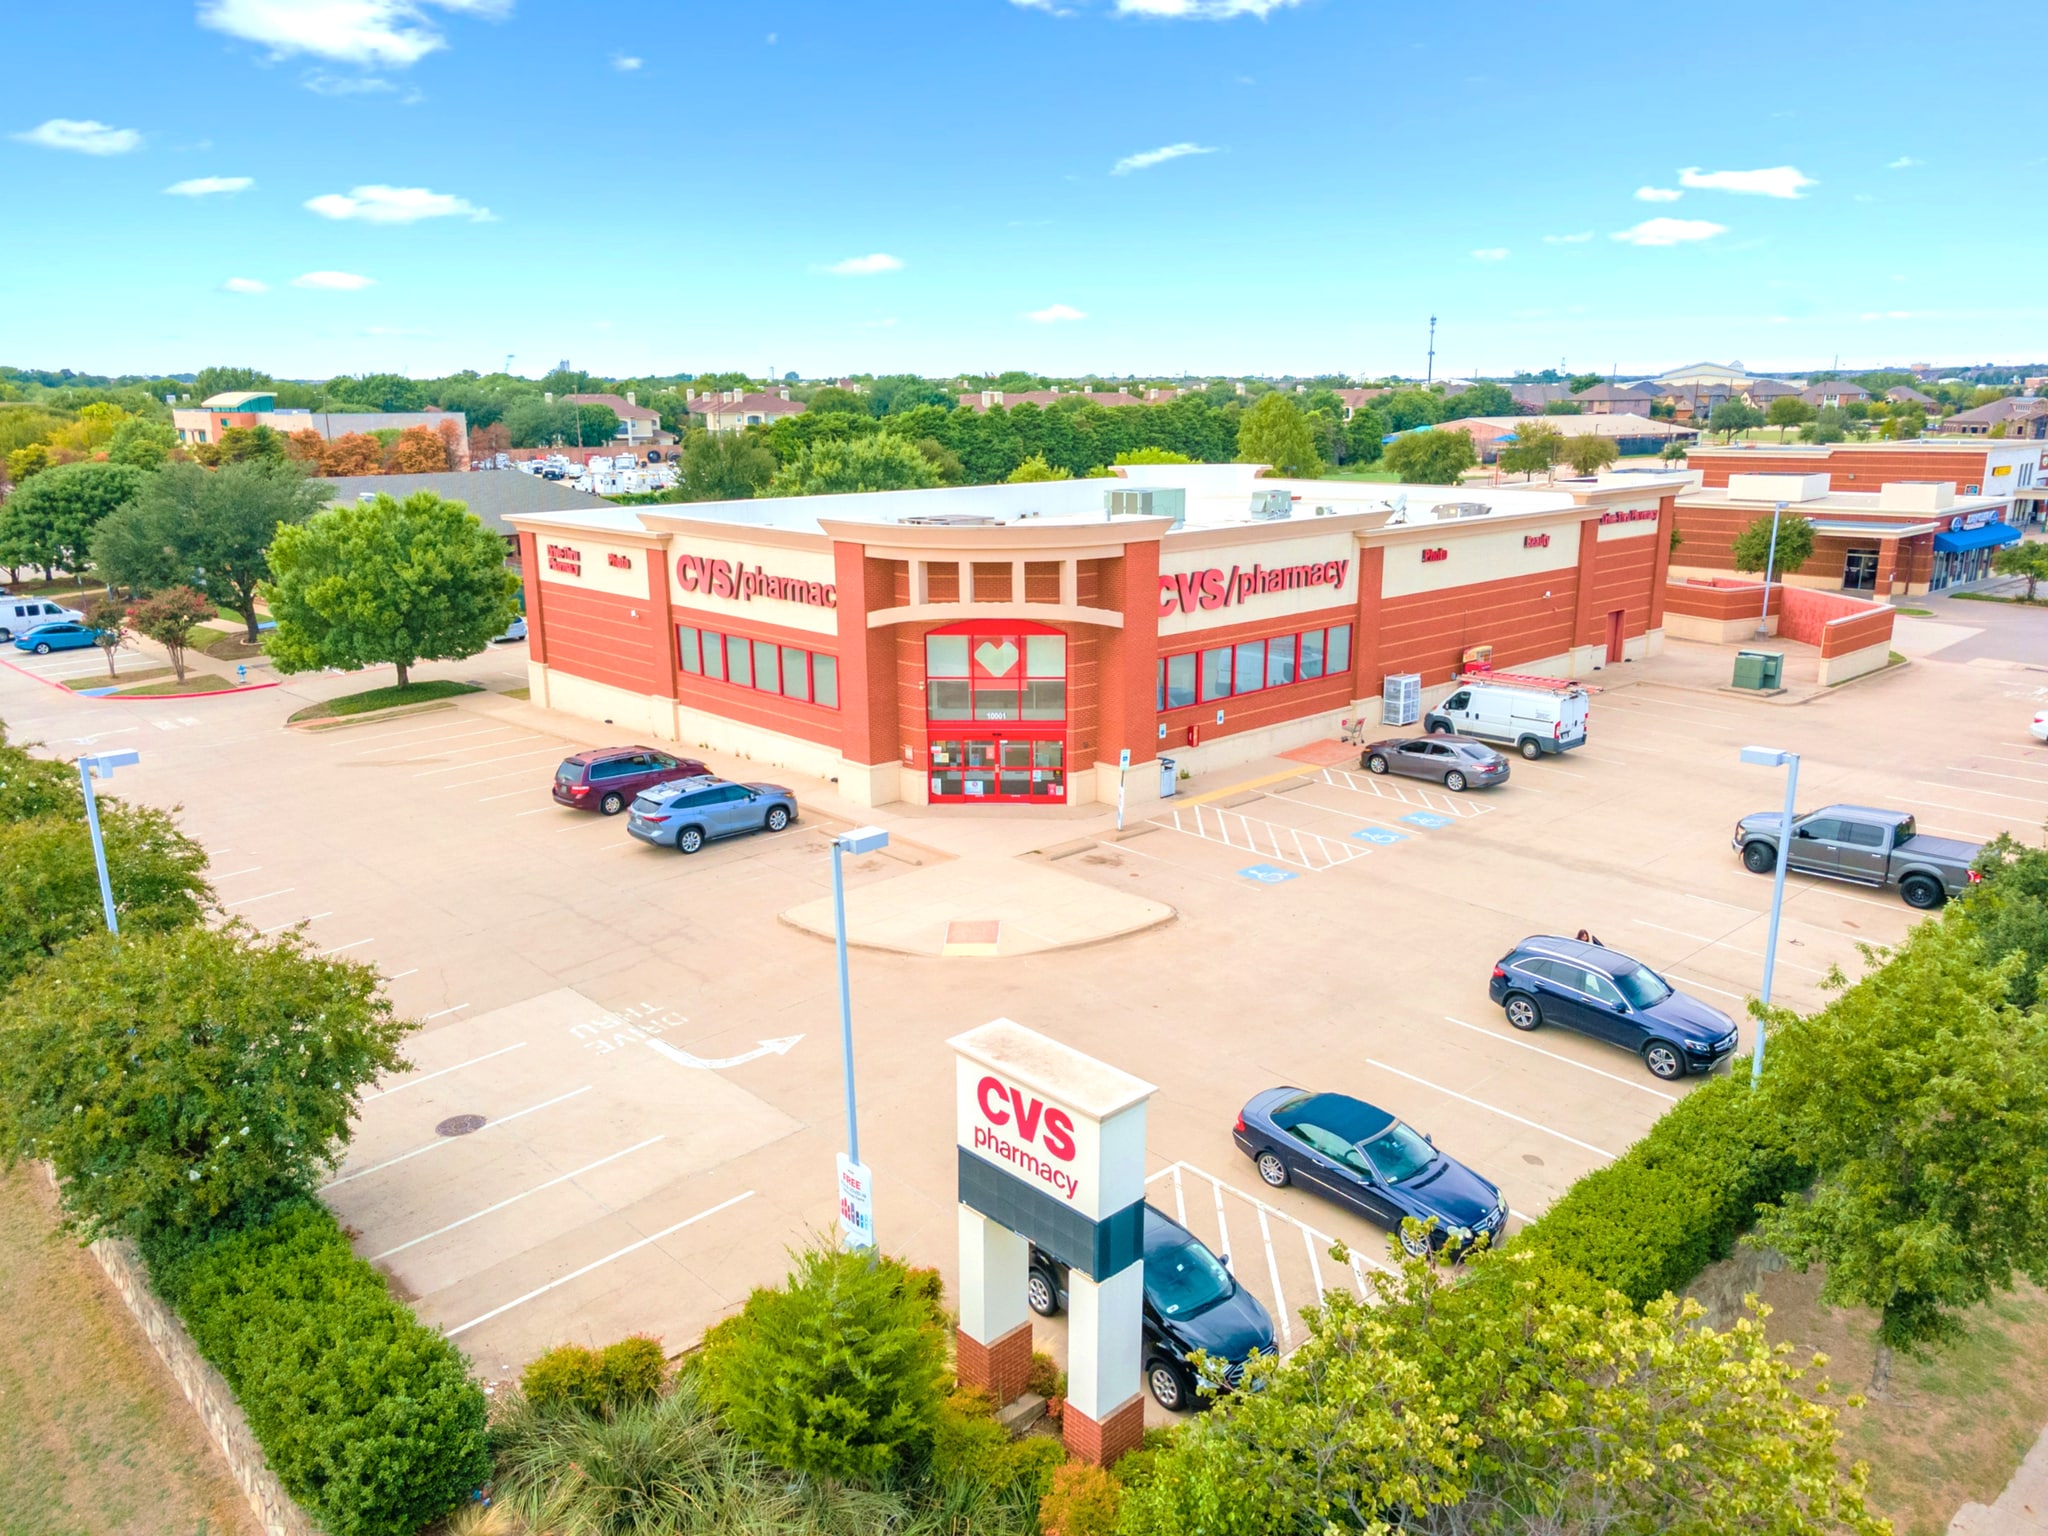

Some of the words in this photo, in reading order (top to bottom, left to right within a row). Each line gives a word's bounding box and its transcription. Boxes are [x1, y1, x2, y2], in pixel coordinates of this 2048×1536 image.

[1524, 534, 1550, 548] Beauty
[608, 553, 631, 569] Photo
[1422, 548, 1447, 562] Photo
[676, 554, 836, 608] CVS/pharmac
[1158, 559, 1349, 617] CVS/pharmacy
[986, 711, 1006, 720] 10001
[977, 1076, 1076, 1162] CVS
[974, 1125, 1078, 1200] pharmacy
[843, 1171, 861, 1191] FREE
